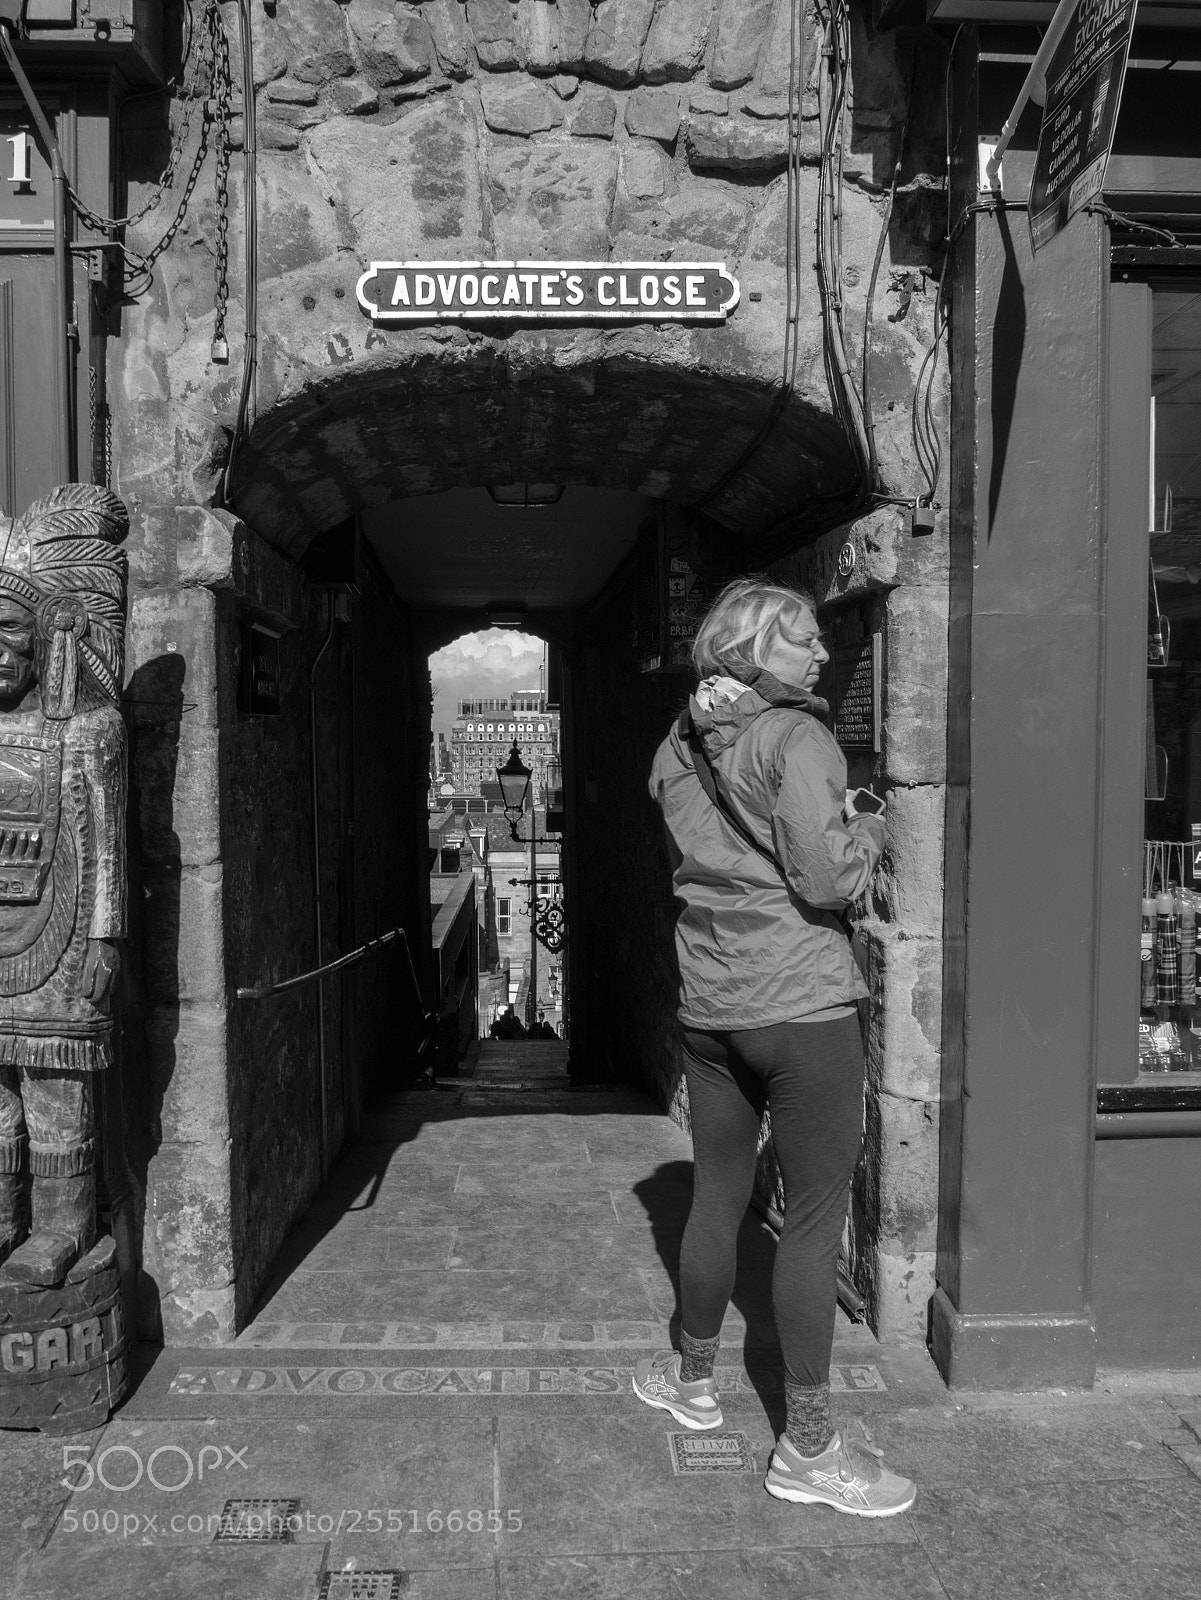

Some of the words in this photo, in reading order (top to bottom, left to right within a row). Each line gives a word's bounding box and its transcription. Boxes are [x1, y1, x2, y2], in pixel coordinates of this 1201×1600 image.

[1102, 9, 1127, 39] CHANGE
[1088, 38, 1111, 66] CHANGE
[1051, 135, 1062, 153] US
[1060, 110, 1083, 145] DOLLAR
[1054, 104, 1071, 132] EURO
[1048, 133, 1079, 175] CANADIAN
[1044, 150, 1082, 198] AUSTRALIAN
[391, 270, 584, 307] ADVOCATE'S
[597, 275, 707, 307] CLOSE
[184, 1366, 619, 1394] ADVOCATE'S
[685, 1440, 738, 1450] WATER
